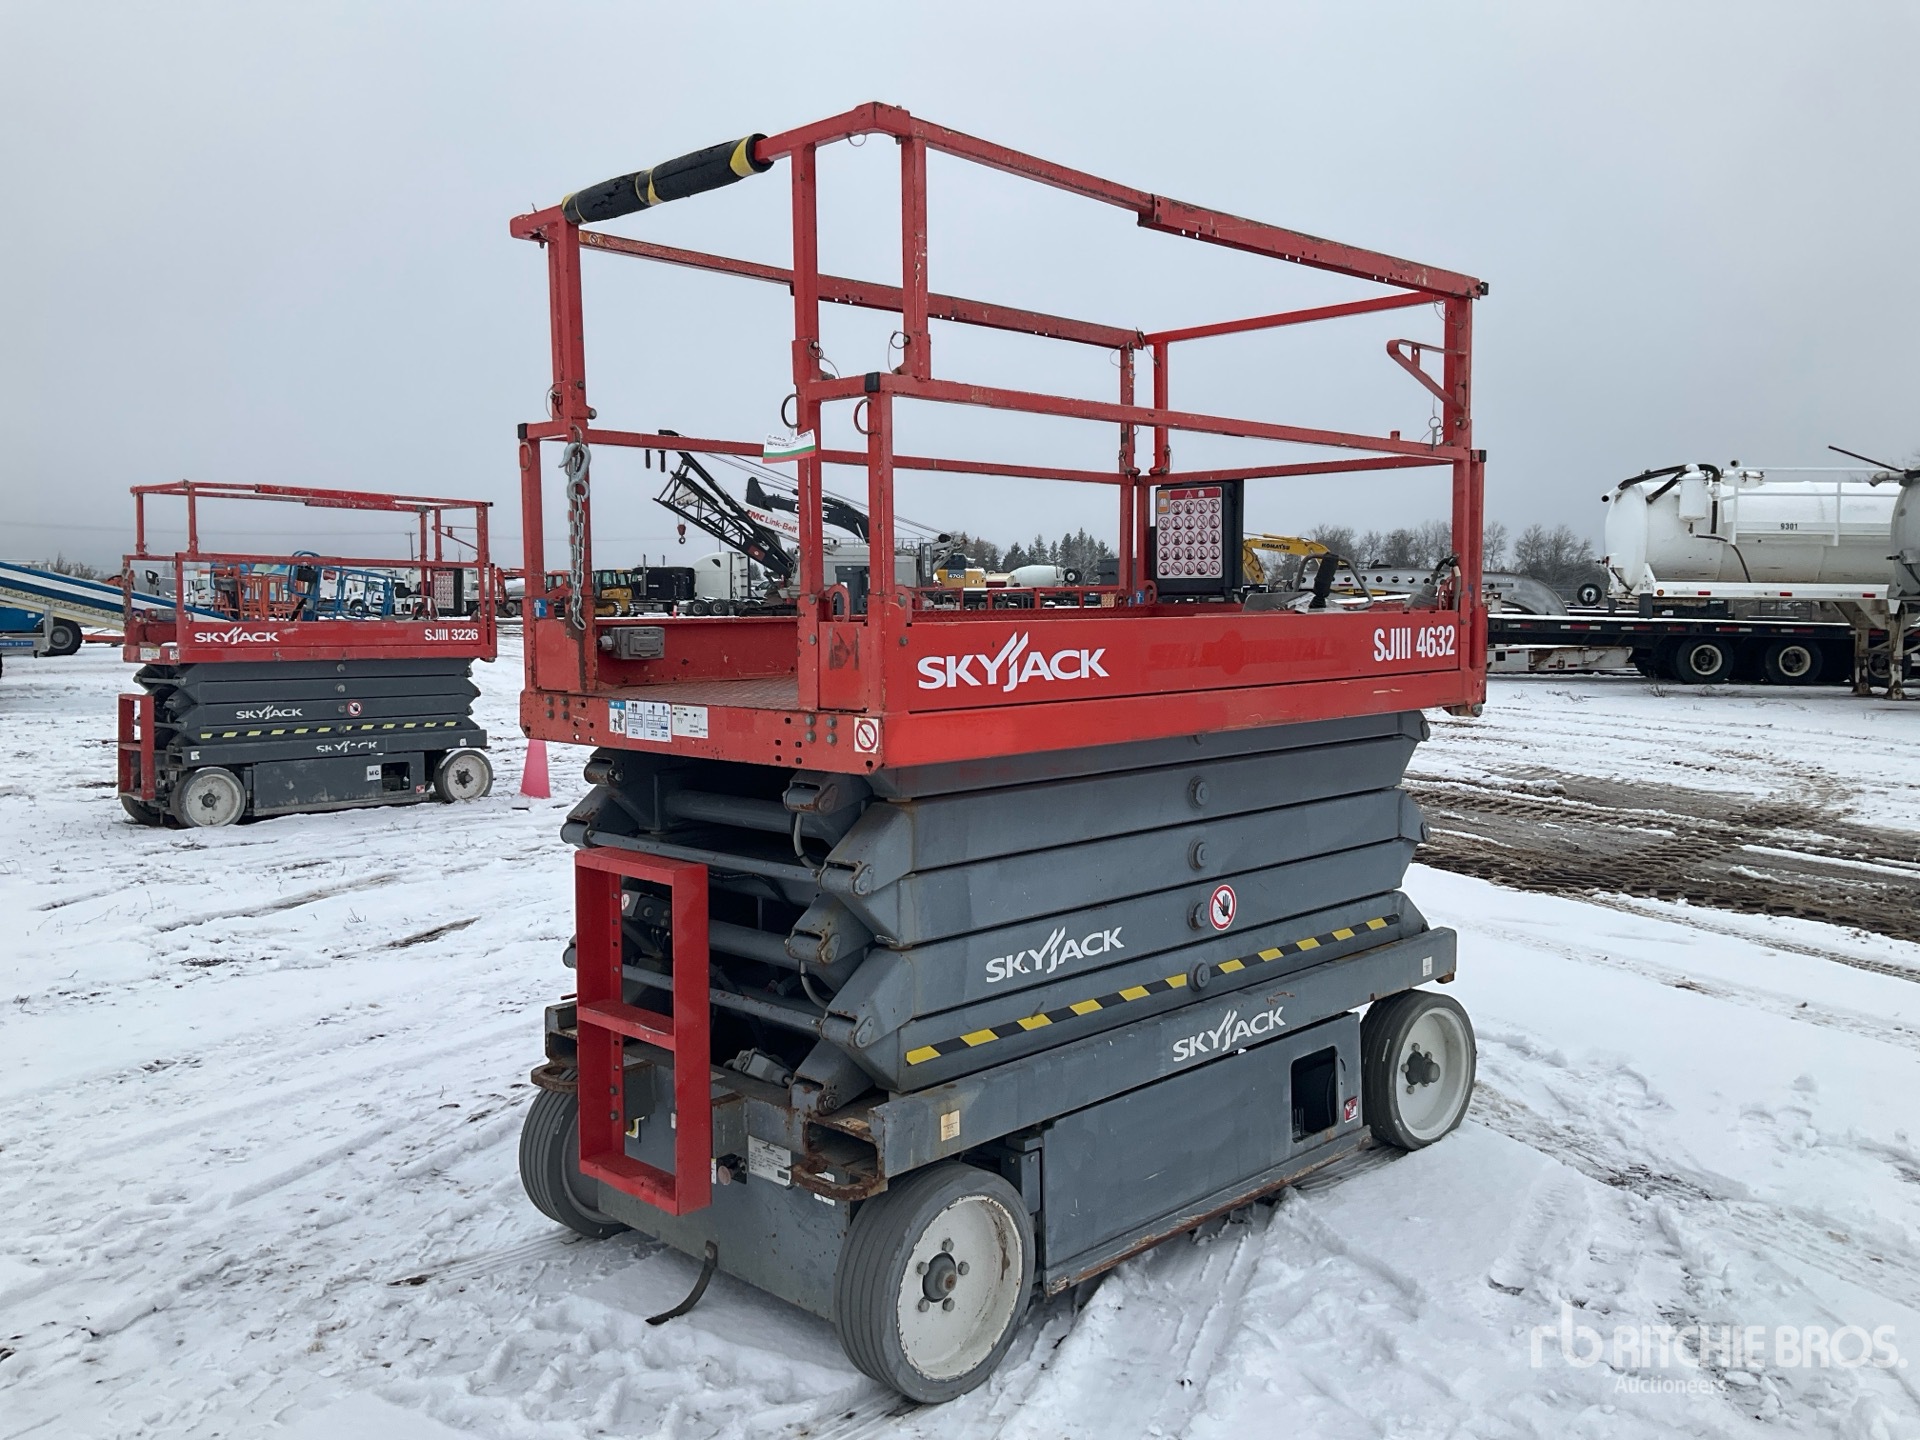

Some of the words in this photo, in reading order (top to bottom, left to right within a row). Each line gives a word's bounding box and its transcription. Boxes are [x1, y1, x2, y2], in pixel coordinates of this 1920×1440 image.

[765, 516, 798, 533] Link-Belt
[195, 626, 280, 645] SKYJACK
[424, 629, 449, 642] SJIII
[451, 628, 479, 641] 3226
[1374, 628, 1411, 661] SJIII
[1416, 625, 1455, 657] 4632
[918, 632, 1109, 692] SKYJACK
[236, 705, 303, 719] SKYJACK
[986, 926, 1124, 983] SKYJACK
[1172, 1006, 1286, 1062] SKYJACK
